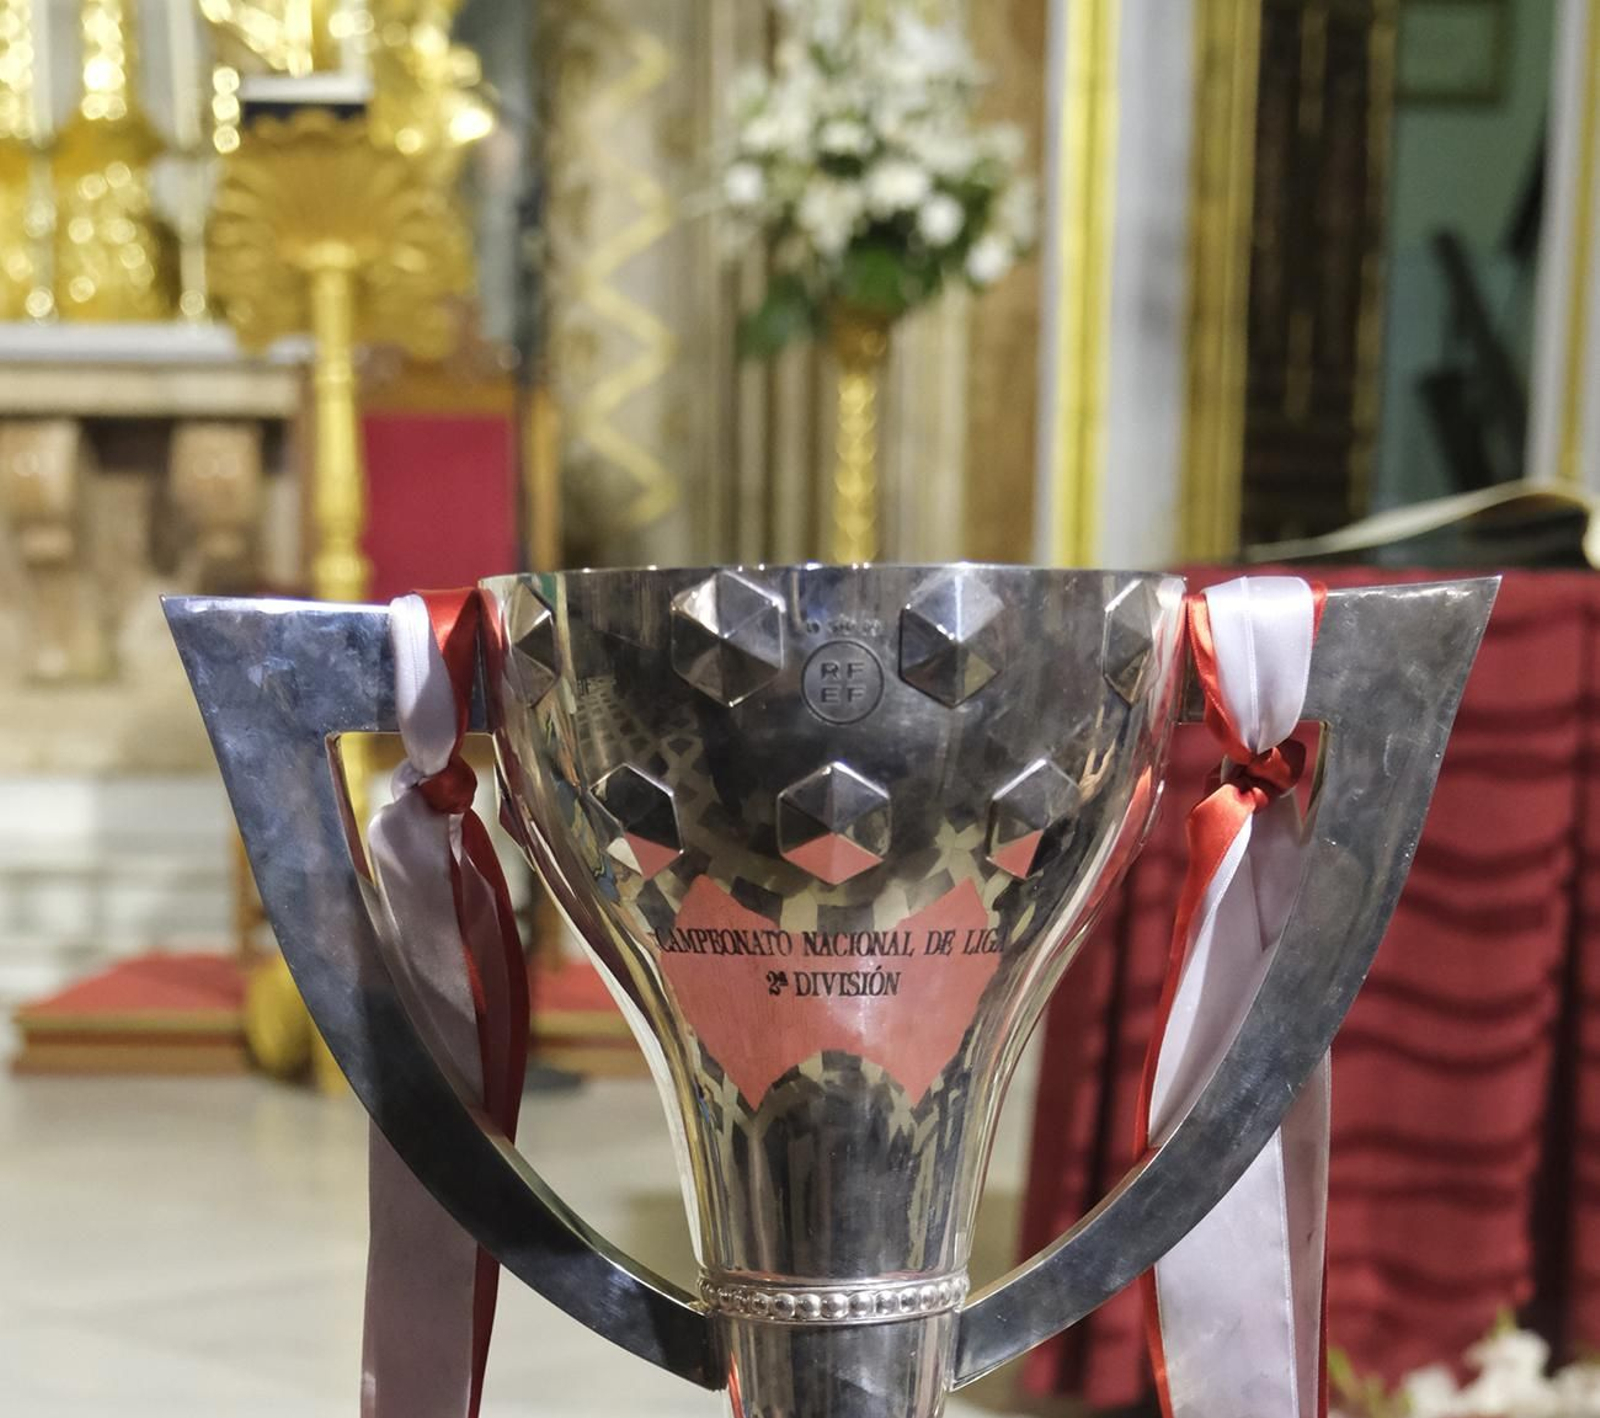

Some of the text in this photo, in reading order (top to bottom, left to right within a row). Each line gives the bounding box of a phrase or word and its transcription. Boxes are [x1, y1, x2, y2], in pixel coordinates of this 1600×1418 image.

[654, 925, 792, 957] CAMPEONATO
[803, 929, 916, 957] NACIONAL
[923, 928, 956, 956] DE
[794, 965, 901, 997] DIVISIÓN
